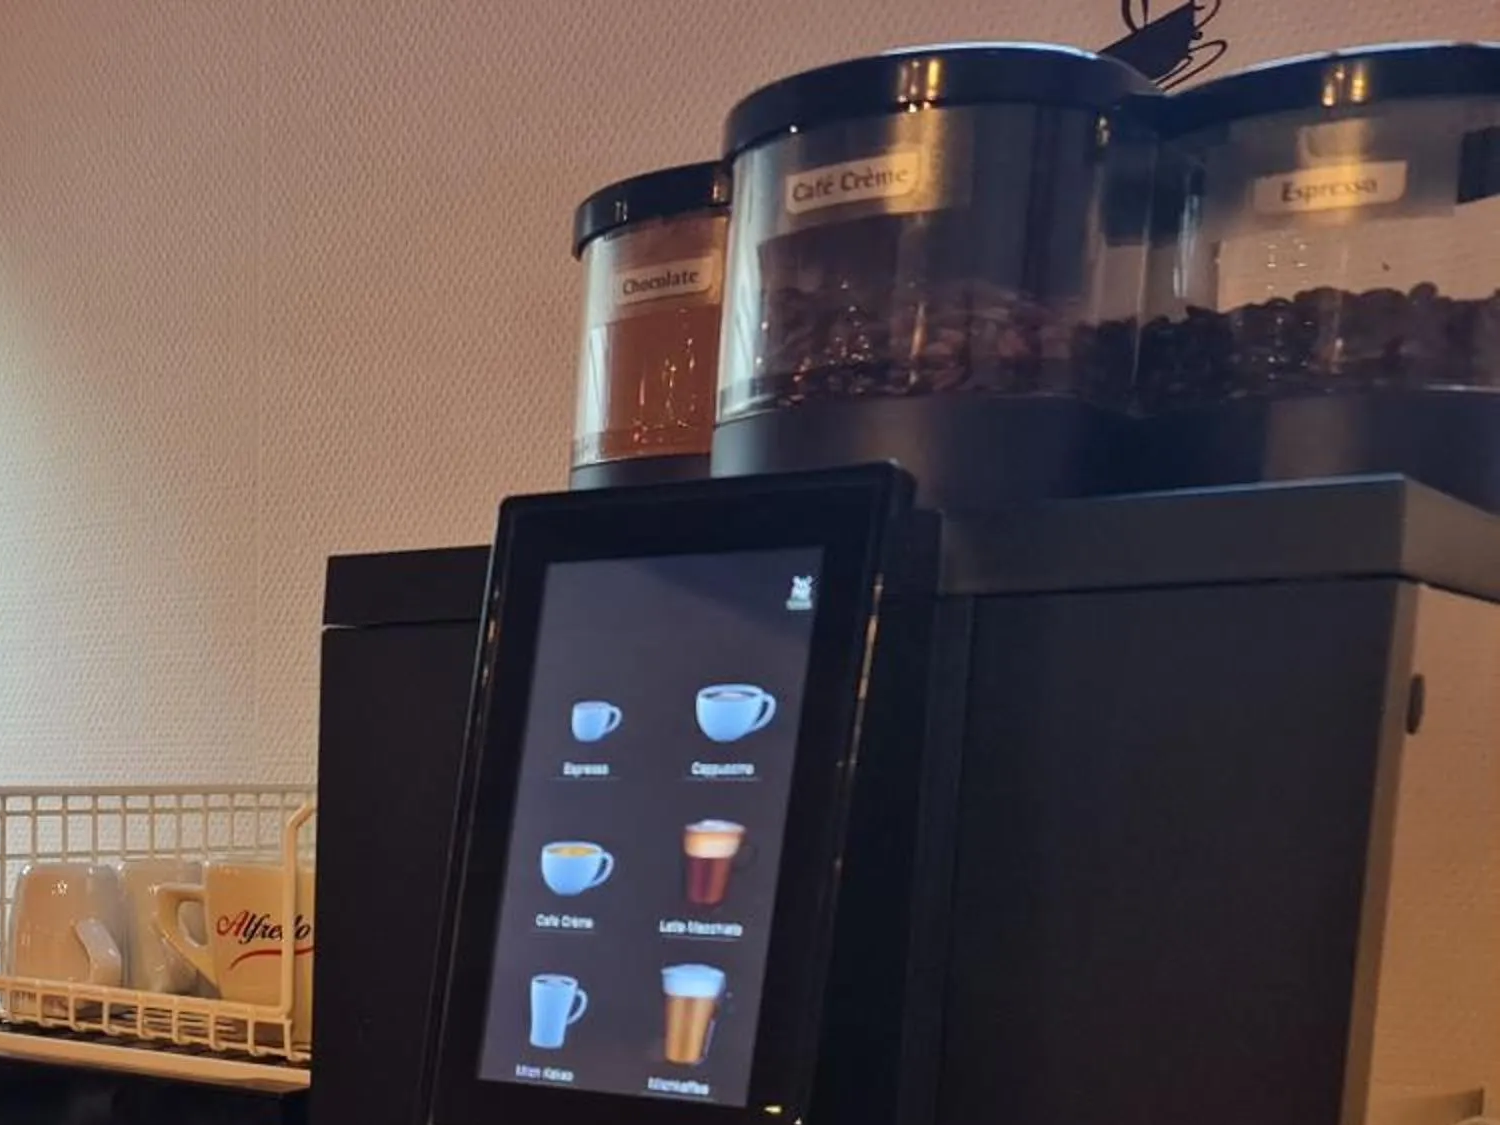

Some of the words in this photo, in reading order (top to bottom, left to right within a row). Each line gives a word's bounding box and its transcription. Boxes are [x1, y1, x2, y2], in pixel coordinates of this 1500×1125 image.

[792, 176, 833, 200] Café
[840, 164, 909, 191] Crème
[1281, 178, 1378, 203] Espresso
[622, 269, 700, 295] Chocolate
